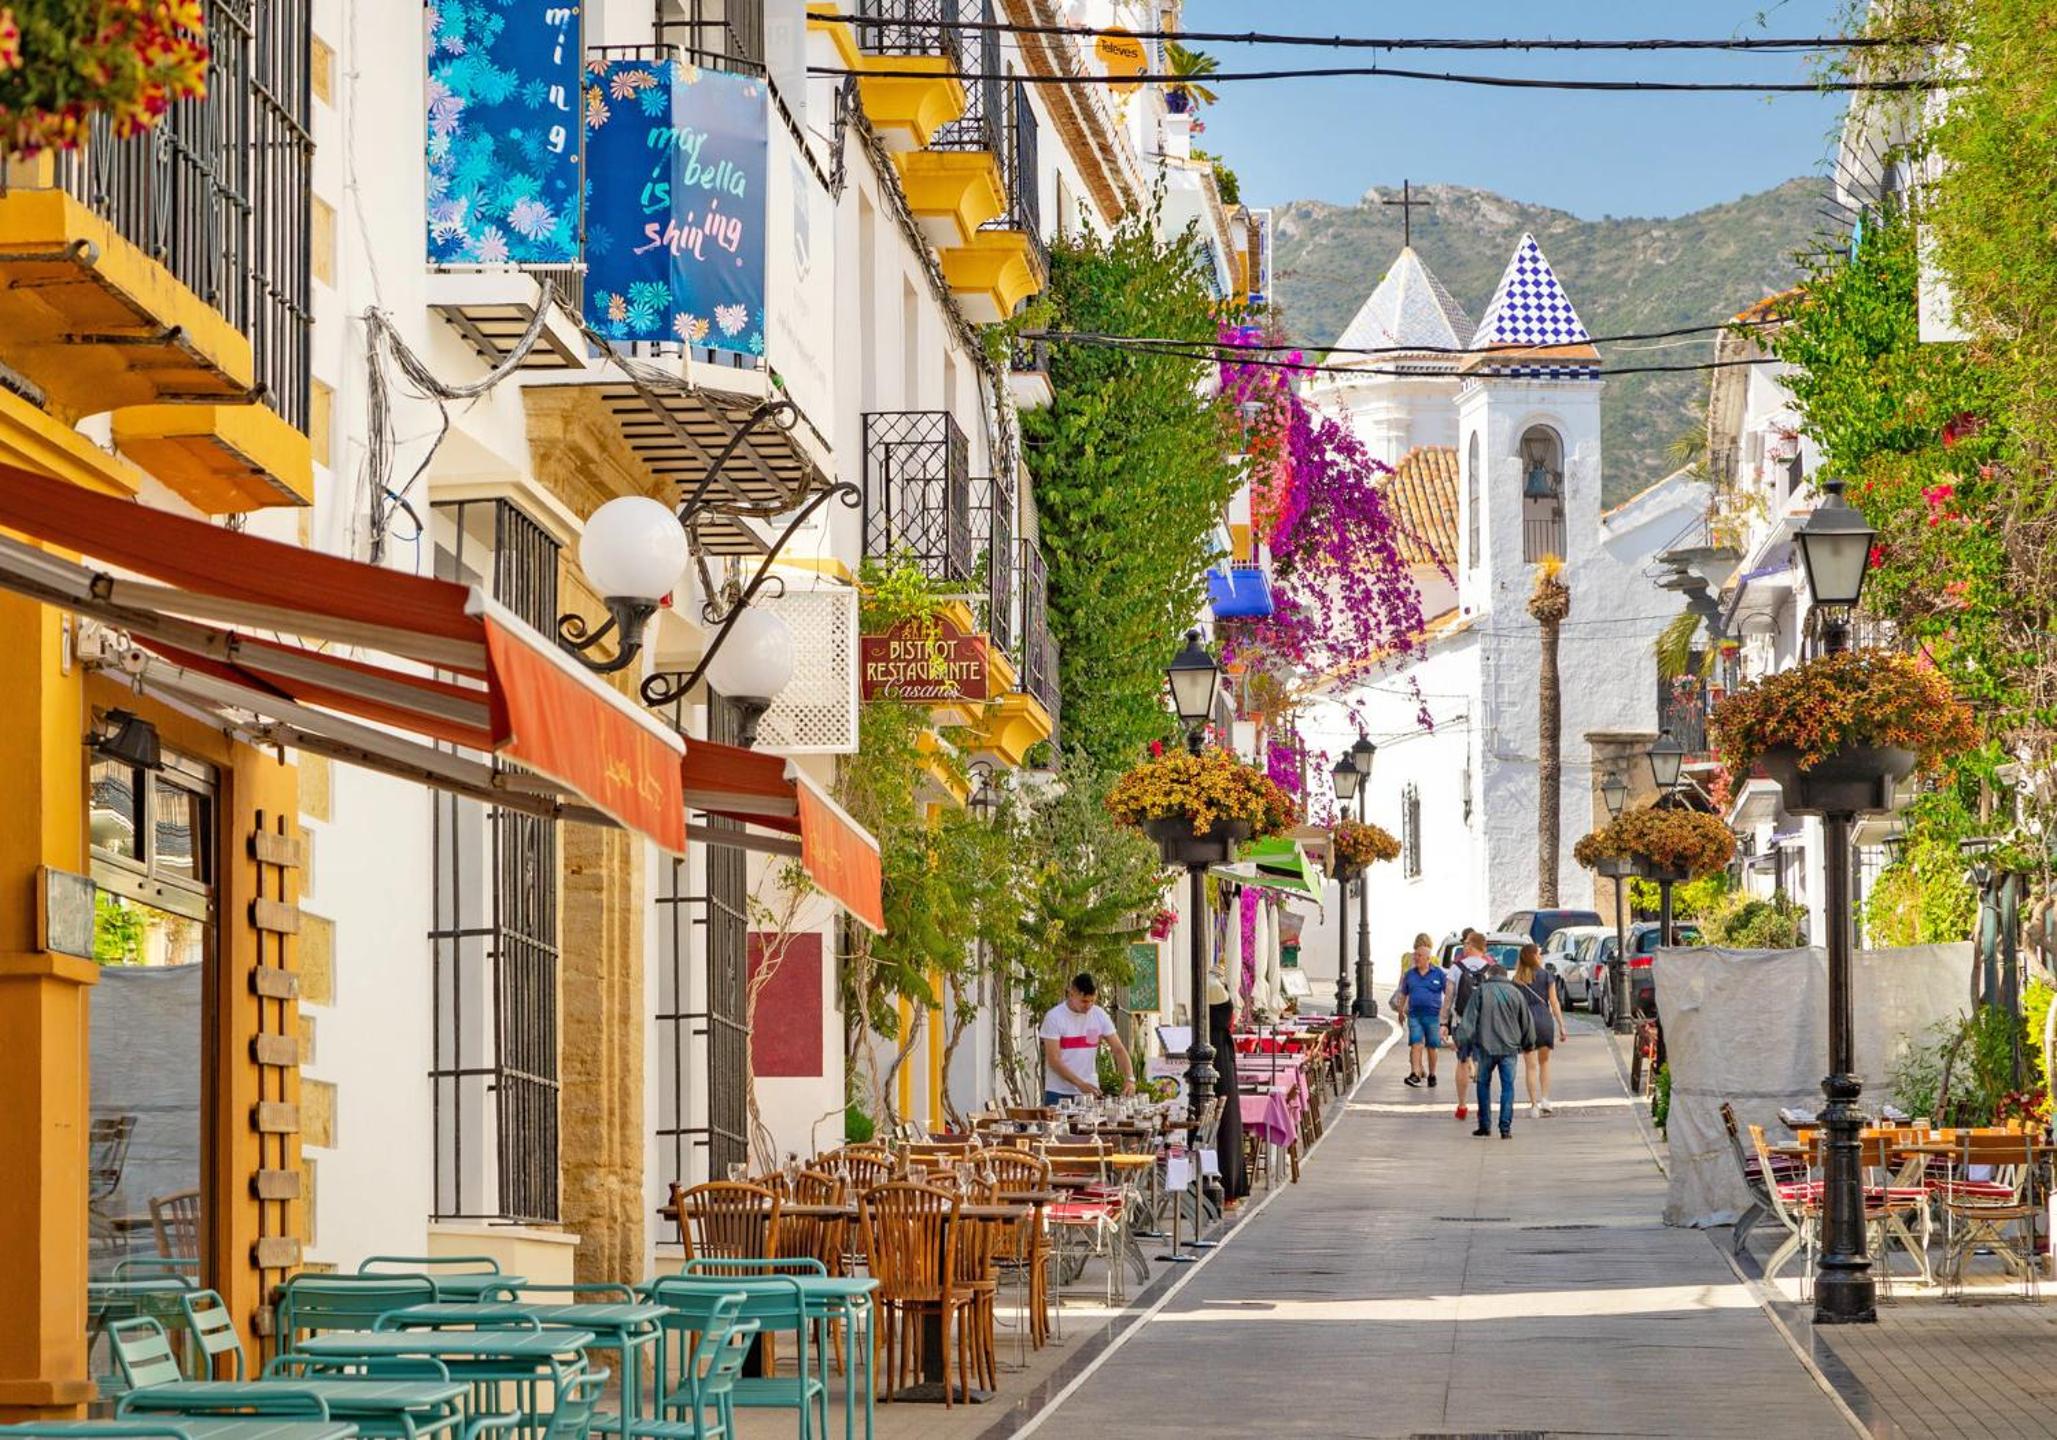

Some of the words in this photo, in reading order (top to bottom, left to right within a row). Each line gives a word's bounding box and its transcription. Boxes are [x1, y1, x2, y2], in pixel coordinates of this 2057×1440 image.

[646, 126, 708, 156] mar
[641, 166, 671, 214] is
[684, 152, 746, 198] bella
[889, 640, 958, 659] BISTROT
[867, 661, 981, 681] RESTAURANTE
